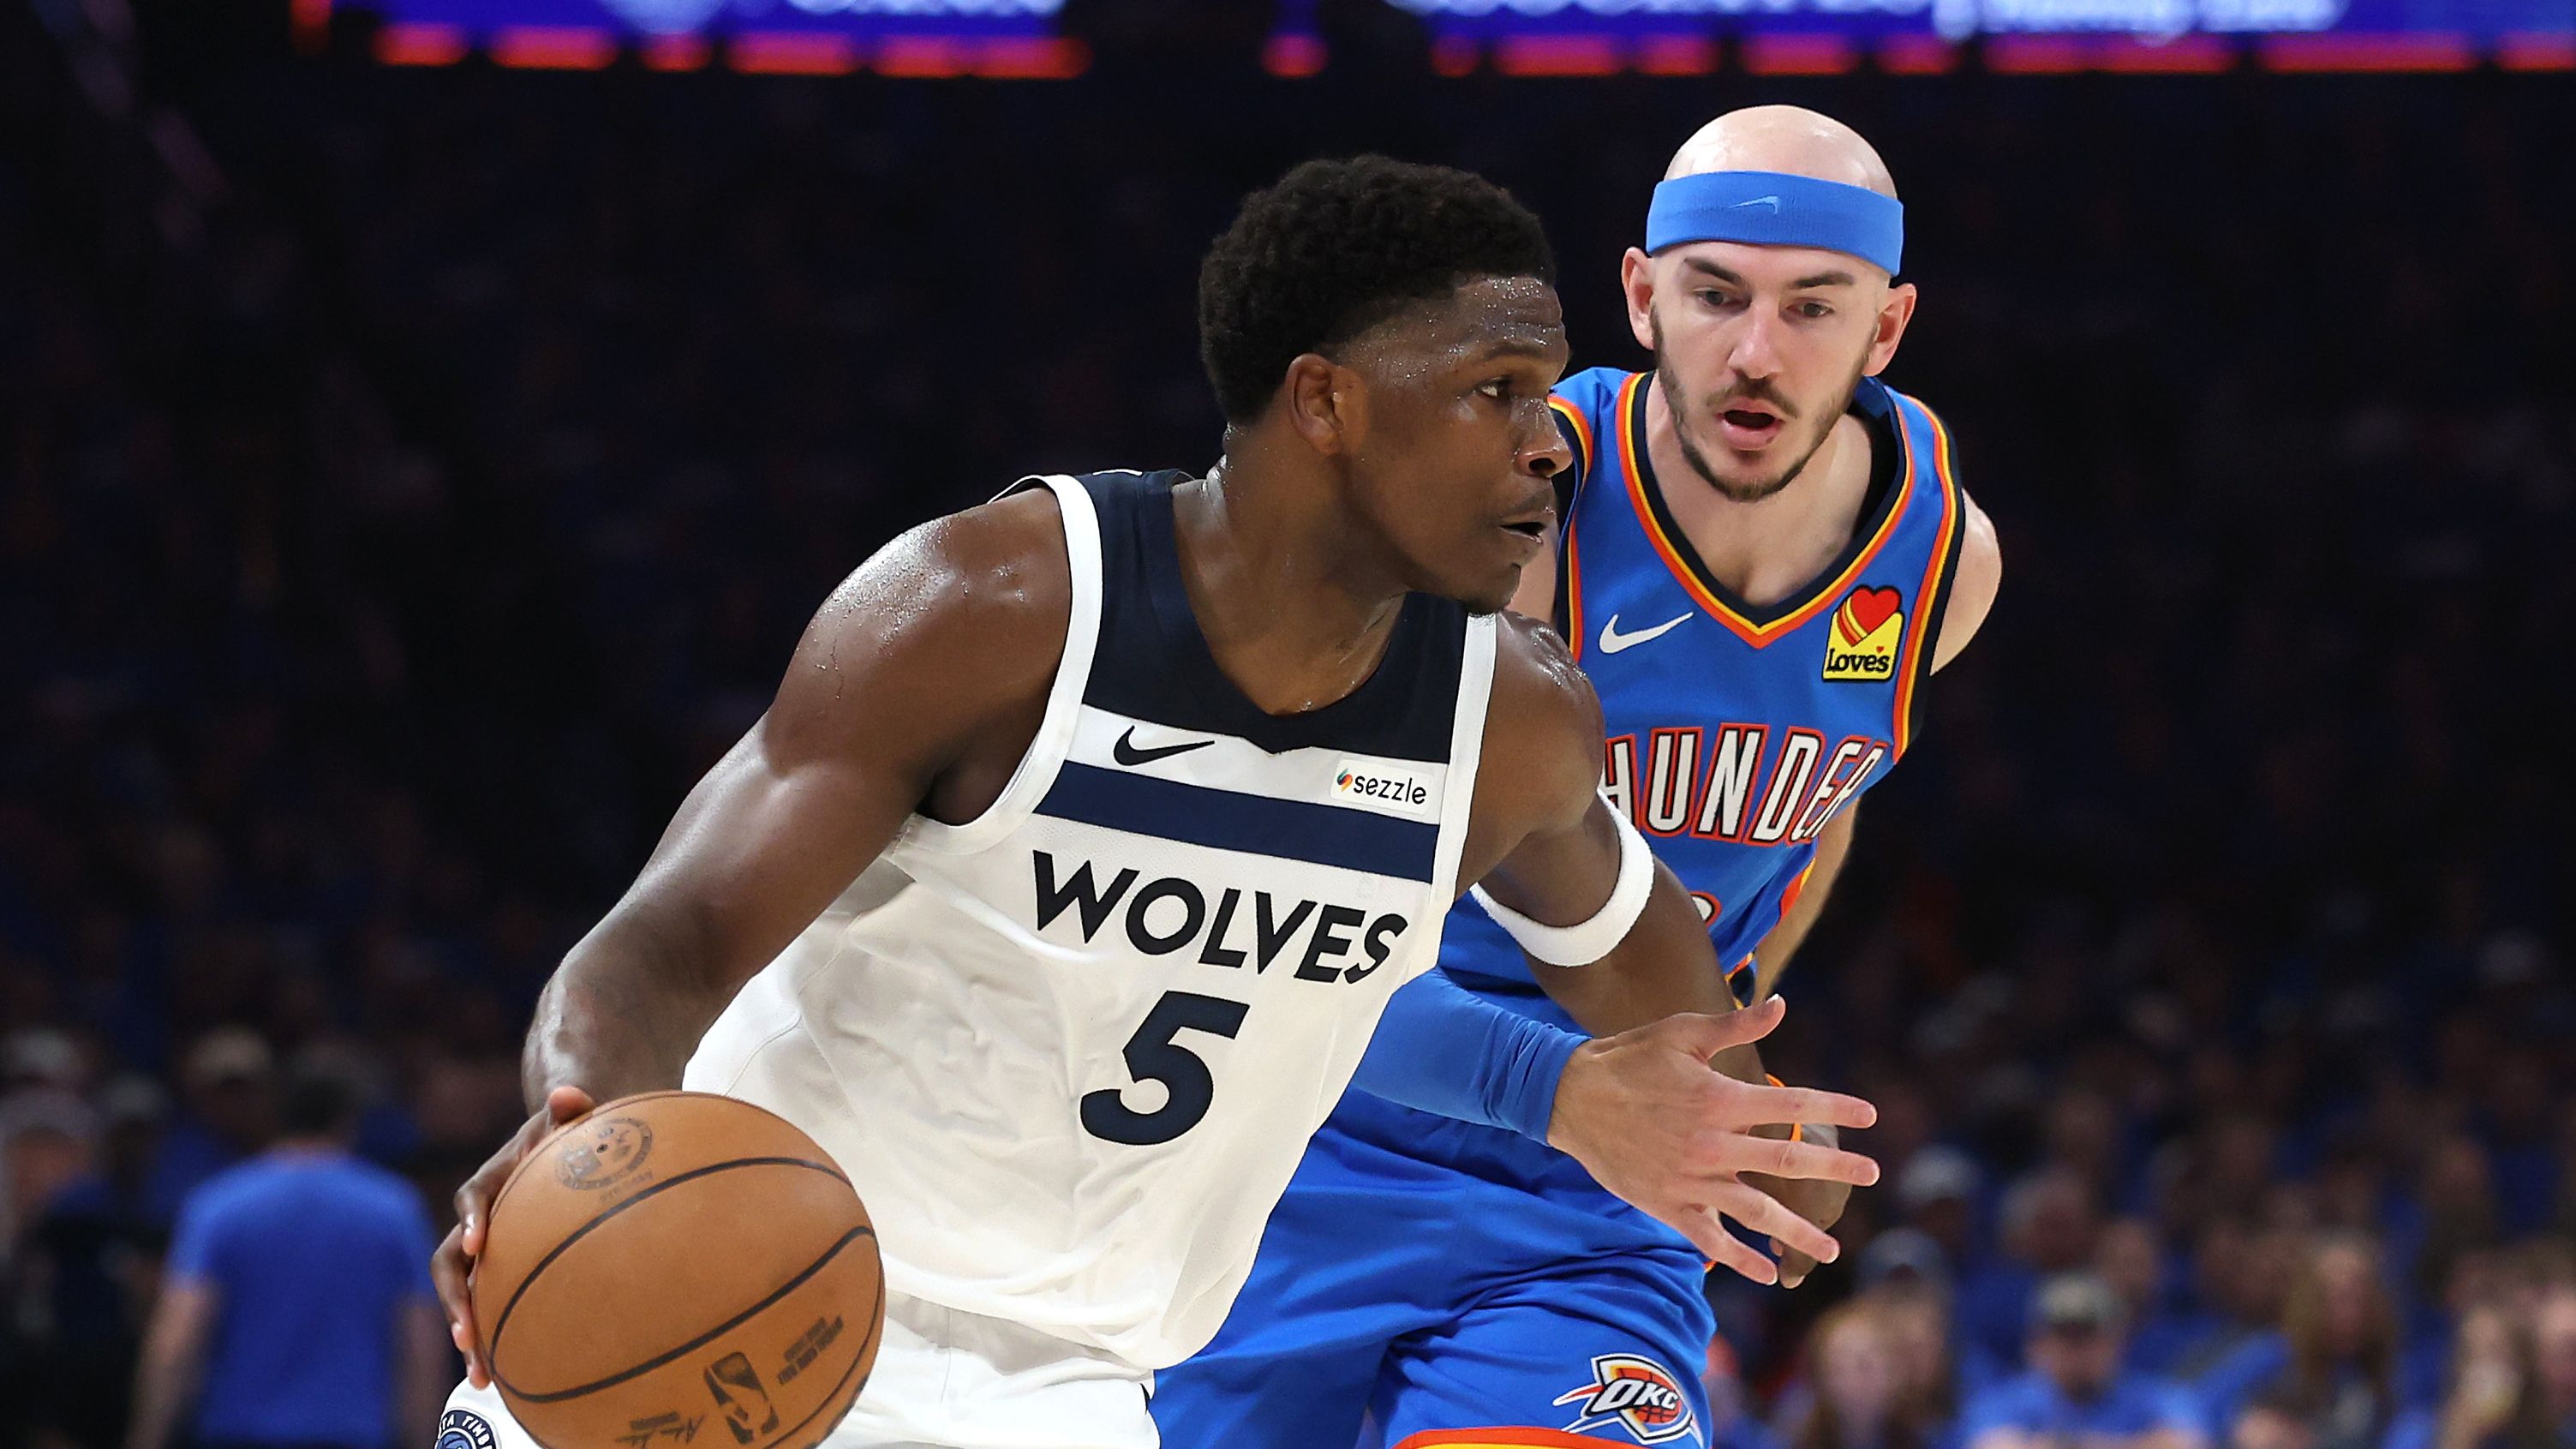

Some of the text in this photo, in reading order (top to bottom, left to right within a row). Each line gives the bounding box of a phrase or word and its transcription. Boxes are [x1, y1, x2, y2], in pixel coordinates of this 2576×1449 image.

[1354, 775, 1426, 805] sezzle
[1604, 722, 1890, 846] HUNDER
[1032, 849, 1408, 984] WOLVES
[1080, 990, 1250, 1146] 5
[1589, 1377, 1679, 1414] OKC
